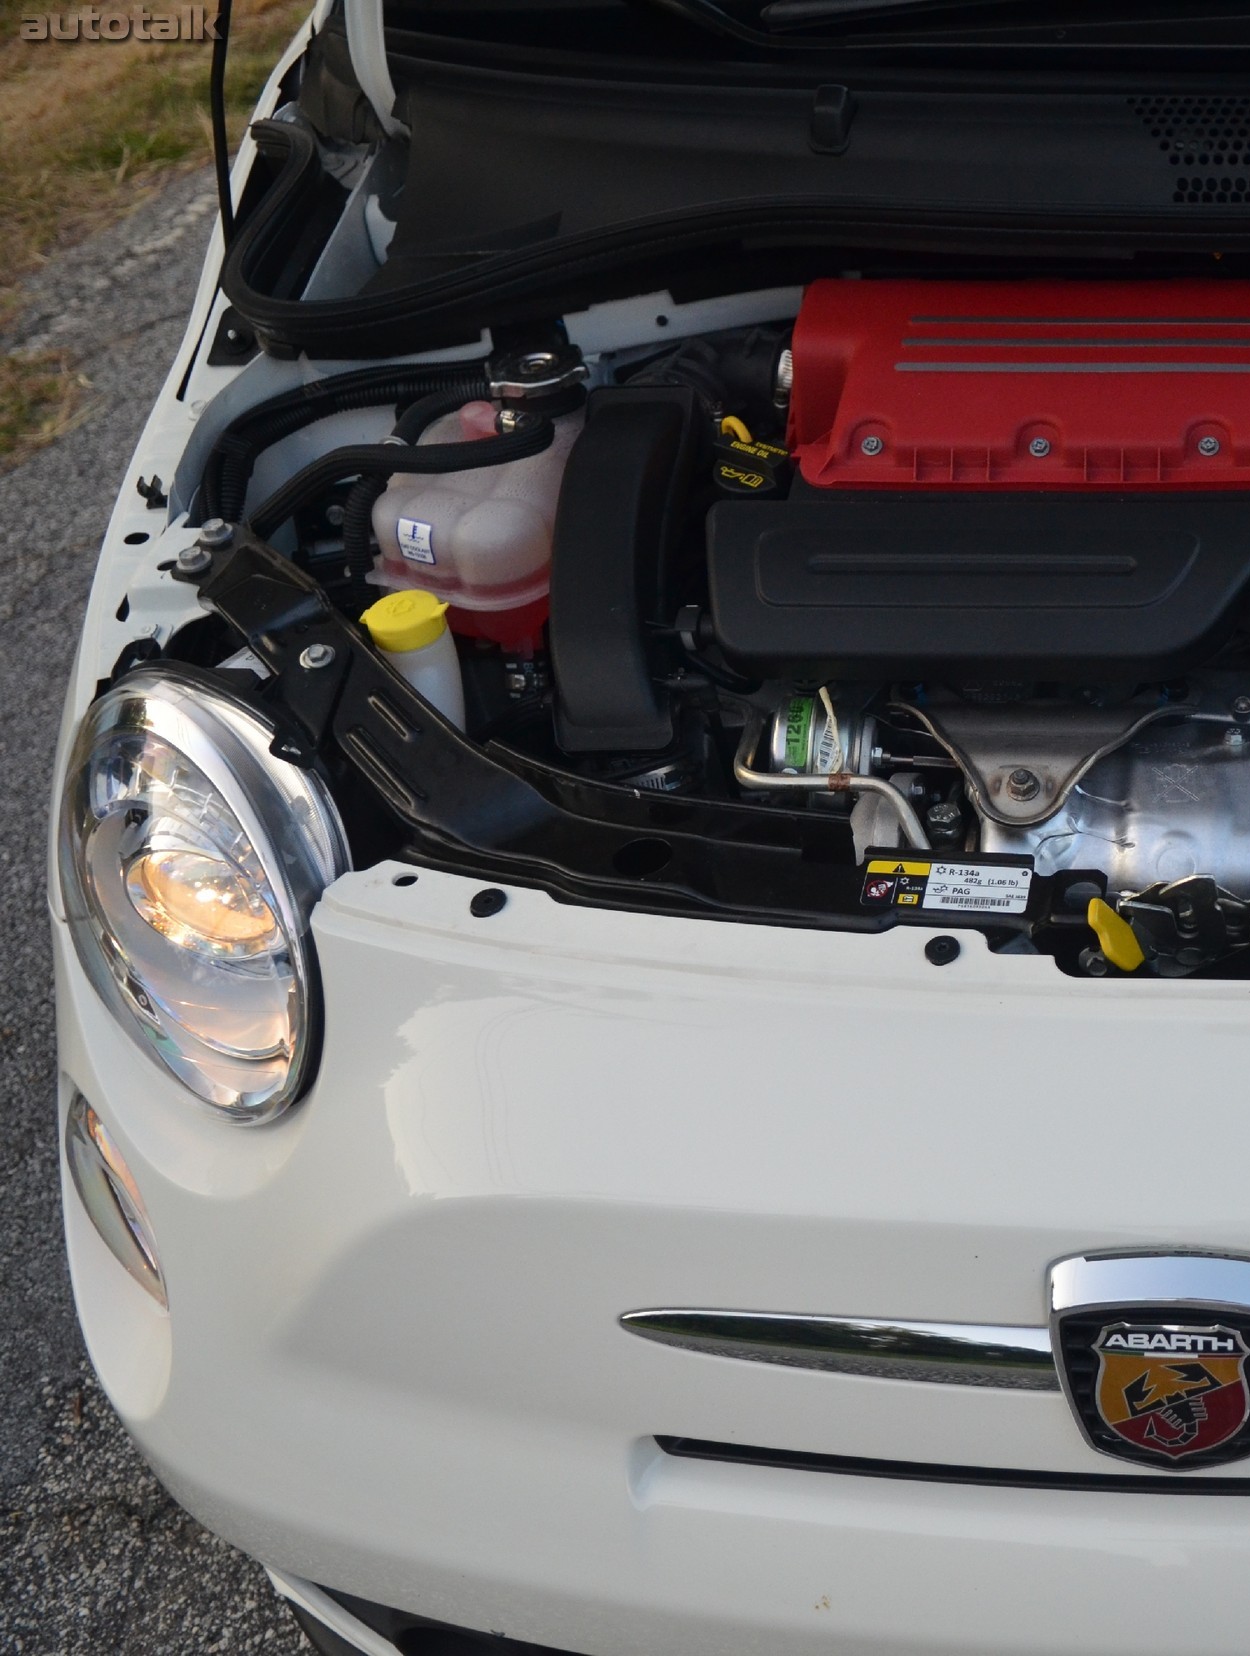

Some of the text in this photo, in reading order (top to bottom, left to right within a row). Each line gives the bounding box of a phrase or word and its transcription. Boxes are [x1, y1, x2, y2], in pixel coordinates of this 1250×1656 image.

[730, 441, 769, 458] ENGINE OIL
[948, 868, 980, 877] R-134a
[964, 878, 982, 886] 482g
[1008, 879, 1019, 887] lb)
[952, 887, 971, 896] PAG
[1105, 1333, 1234, 1351] ABARTH
